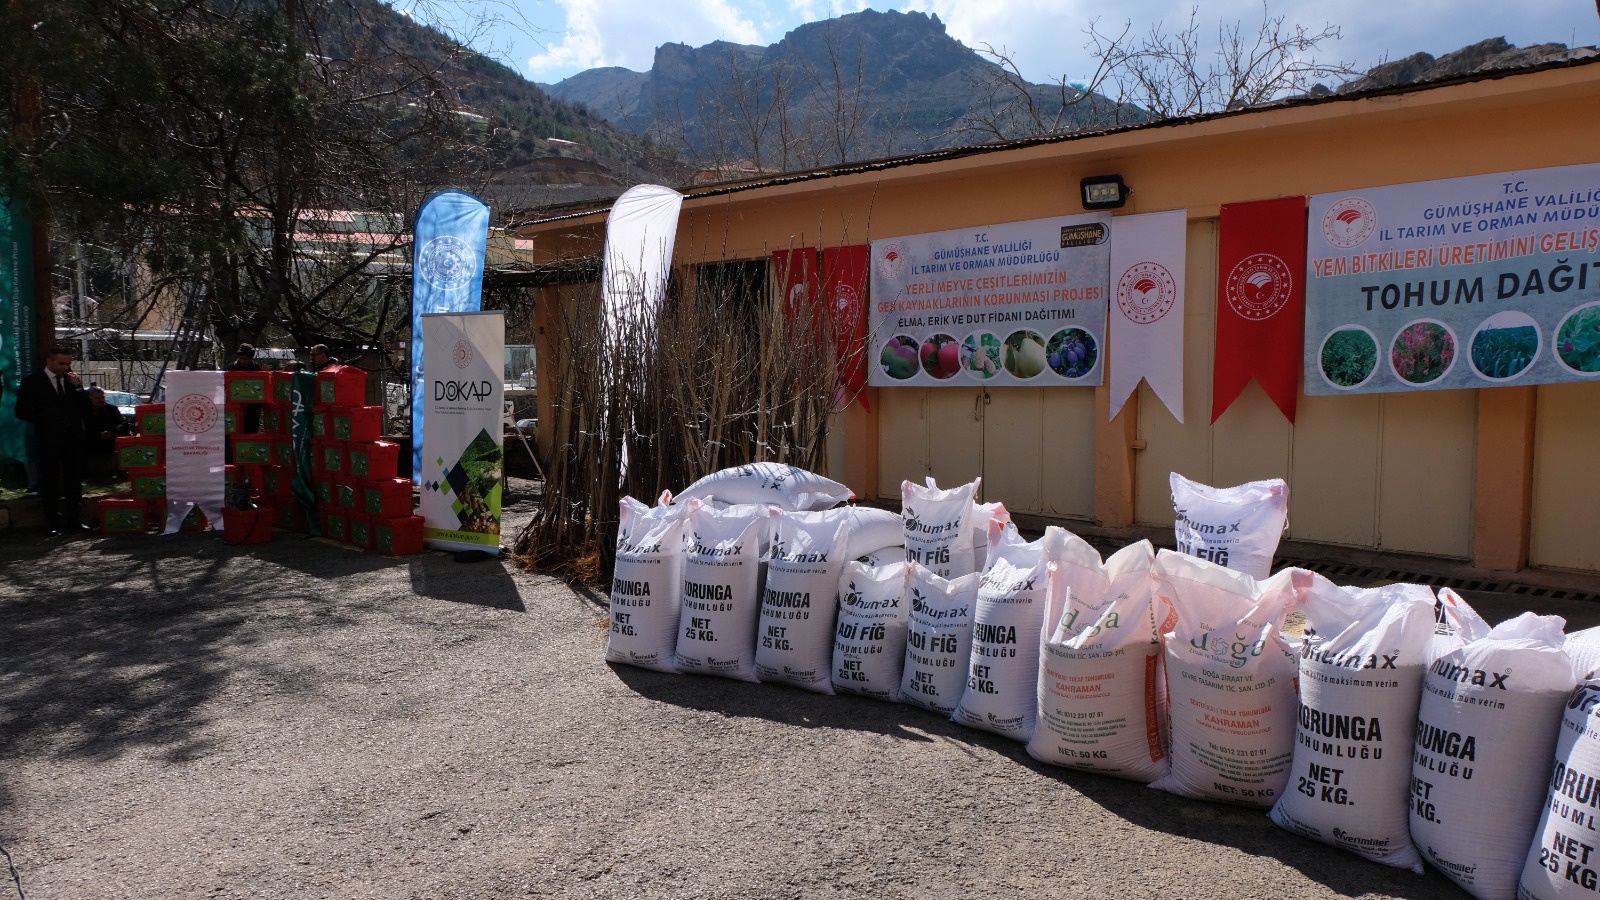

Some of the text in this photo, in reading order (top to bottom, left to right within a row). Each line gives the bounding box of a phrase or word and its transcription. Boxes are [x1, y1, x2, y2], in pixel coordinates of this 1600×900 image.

[1502, 181, 1528, 194] T.C.
[1424, 196, 1529, 220] GÜMÜŞHANE
[1061, 230, 1102, 241] GÜMÜŞHANE
[1380, 227, 1393, 241] İL
[1397, 223, 1446, 239] TARIM
[1452, 221, 1472, 234] VE
[1477, 212, 1538, 232] ORMAN
[975, 233, 989, 243] T.C.
[934, 239, 1032, 260] GÜMÜŞHANE VALİLİĞİ
[1314, 226, 1599, 278] YEM BİTKİLERİ ÜRETİMİNİ GELİŞ
[911, 250, 1060, 275] İL TARIM VE ORMAN MÜDÜRLÜĞÜ
[905, 269, 1067, 295] YERLİ MEYVE ÇEŞİTLERİMİZİN
[877, 283, 1104, 313] GEN KAYNAKLARININ KORUNMASI PROJESİ
[1361, 276, 1484, 311] TOHUM
[898, 308, 1075, 328] ELMA, ERİK VE DUT FİDANI DAĞITIMI
[435, 381, 492, 402] DOKAP
[925, 545, 950, 565] FİĞ
[615, 612, 631, 625] NET
[691, 617, 711, 630] NET
[611, 621, 638, 637] 25 KG.
[685, 627, 718, 642] 25 KG.
[767, 625, 787, 639] NET
[837, 621, 885, 641] ADİ FİĞ
[974, 622, 1017, 645] RUNGA
[762, 636, 793, 651] 25 KG.
[908, 629, 957, 653] ADİ FİĞ
[843, 660, 862, 671] NET
[908, 648, 956, 668] OHUMLUĞU
[838, 669, 870, 682] 25 KG.
[915, 671, 934, 684] NET
[972, 663, 991, 679] NET
[1202, 669, 1220, 679] DOĞA
[1221, 674, 1243, 682] ZİRAAT
[910, 679, 940, 696] 25 KG.
[968, 676, 999, 694] 25 KG.
[1055, 682, 1101, 693] KAHRAMAN
[1198, 678, 1224, 691] TASARIM
[1238, 685, 1254, 693] SAN.
[1329, 677, 1373, 688] maksimum
[1375, 680, 1399, 688] verim
[1438, 689, 1505, 710] maksimum verim
[1204, 713, 1260, 729] KAHRAMAN
[1057, 746, 1107, 759] NET: 50 KG
[1208, 741, 1267, 757] Tel: 0312 231 07 91
[1308, 762, 1344, 785] NET
[1213, 782, 1275, 797] NET: 50 KG
[1297, 776, 1355, 806] 25 KG.
[1411, 774, 1433, 800] NET
[1416, 798, 1441, 825] KG.
[1552, 831, 1595, 865] NET
[1539, 847, 1560, 874] 25
[1565, 860, 1600, 893] KG
